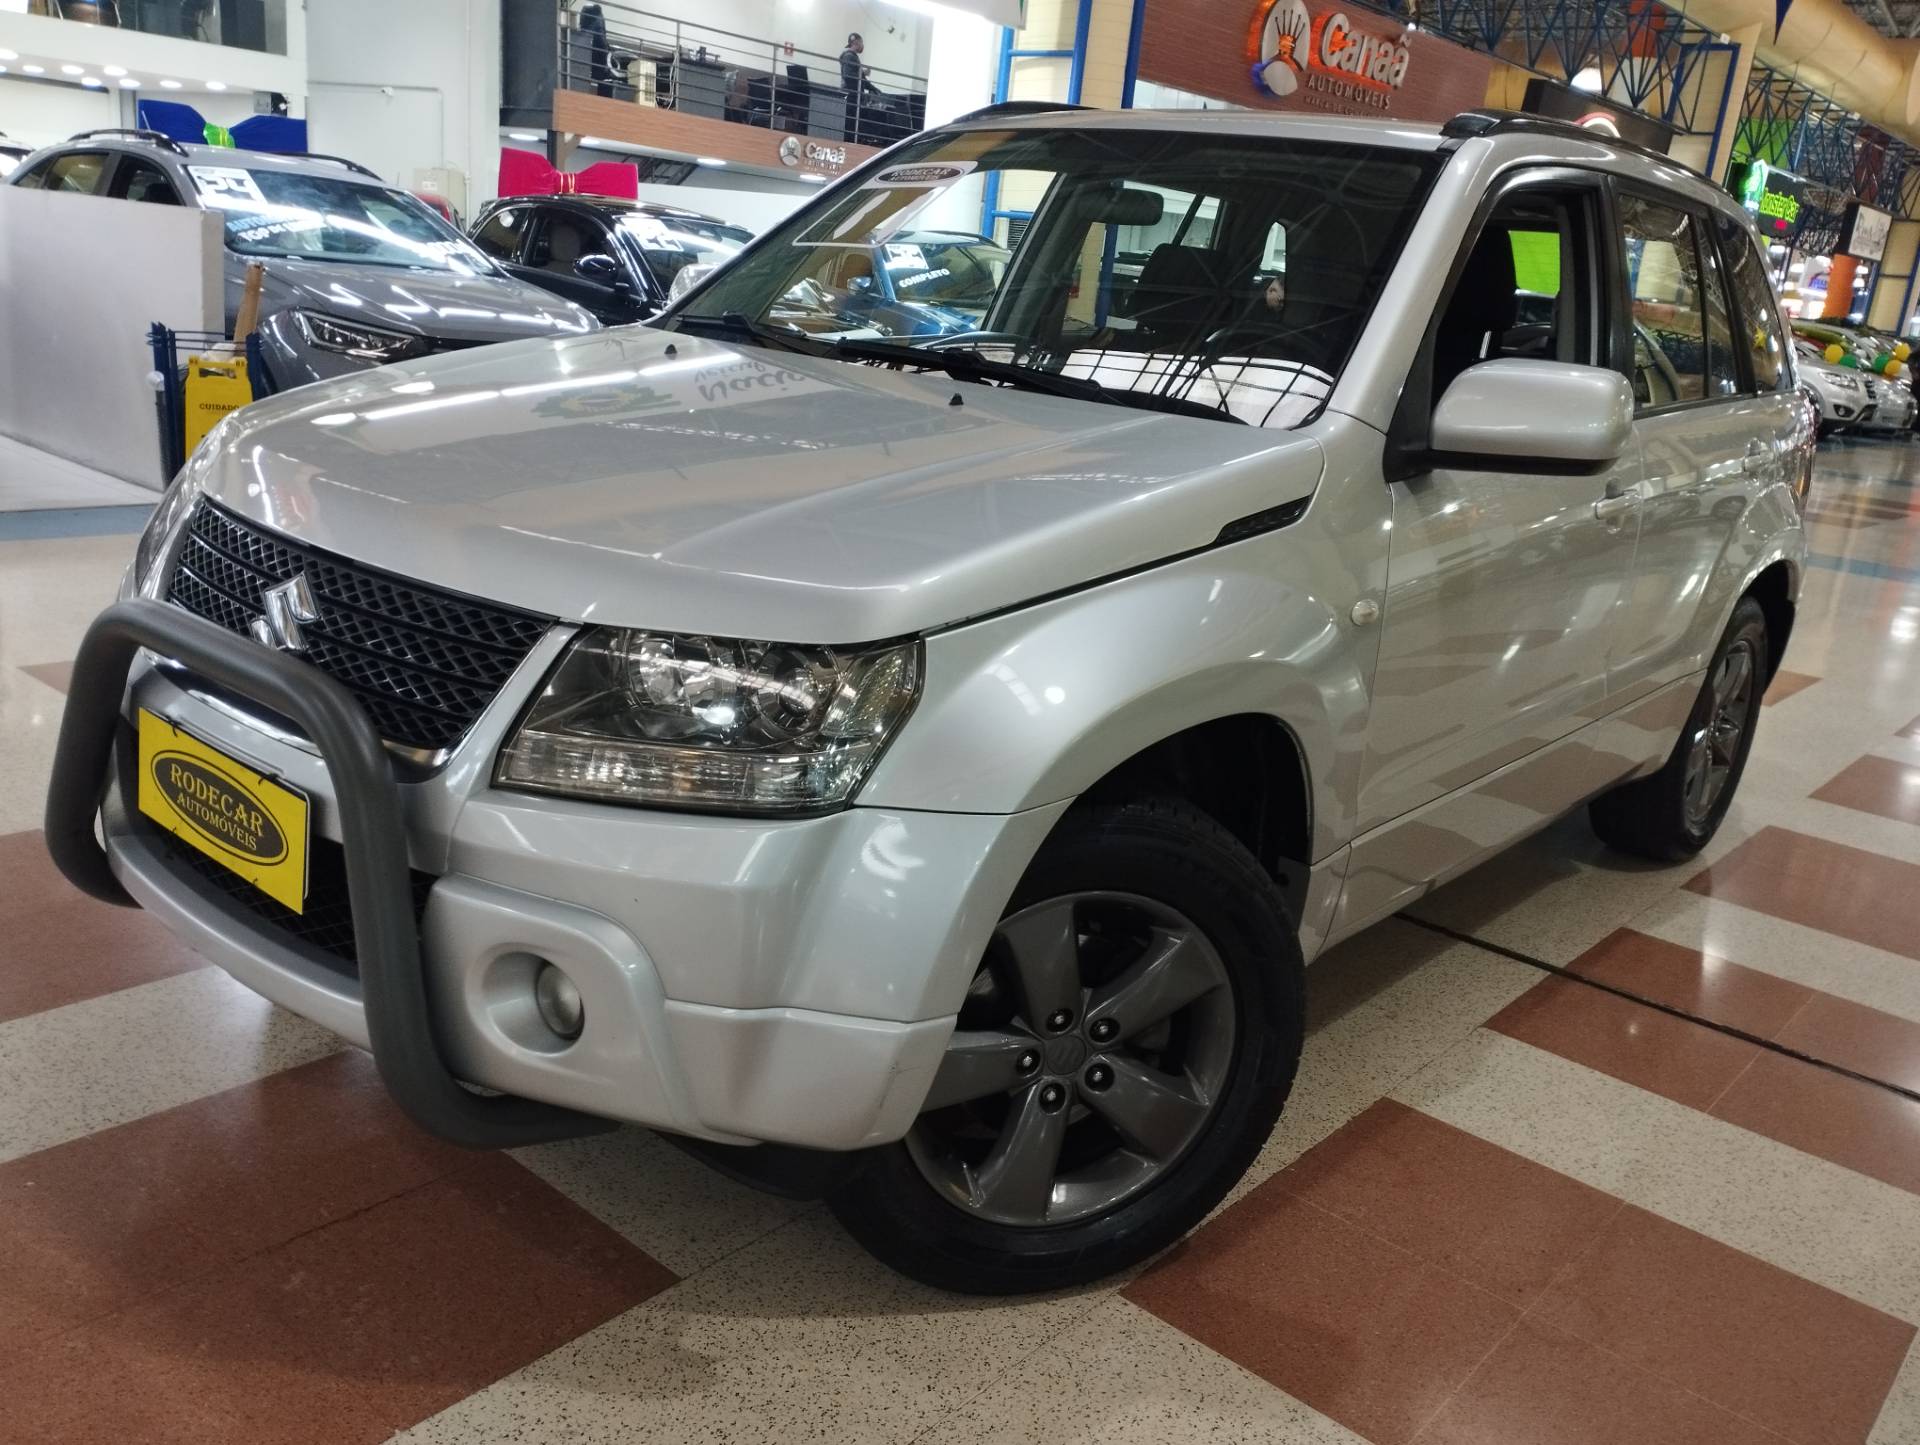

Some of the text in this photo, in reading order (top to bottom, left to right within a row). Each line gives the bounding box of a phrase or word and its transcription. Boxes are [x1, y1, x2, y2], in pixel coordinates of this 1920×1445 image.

[1321, 12, 1411, 89] Canaã
[805, 142, 846, 165] Canaã
[899, 268, 951, 288] COMPLETO
[170, 763, 264, 837] RODECAR
[177, 793, 256, 851] AUTOMÓVEIS
